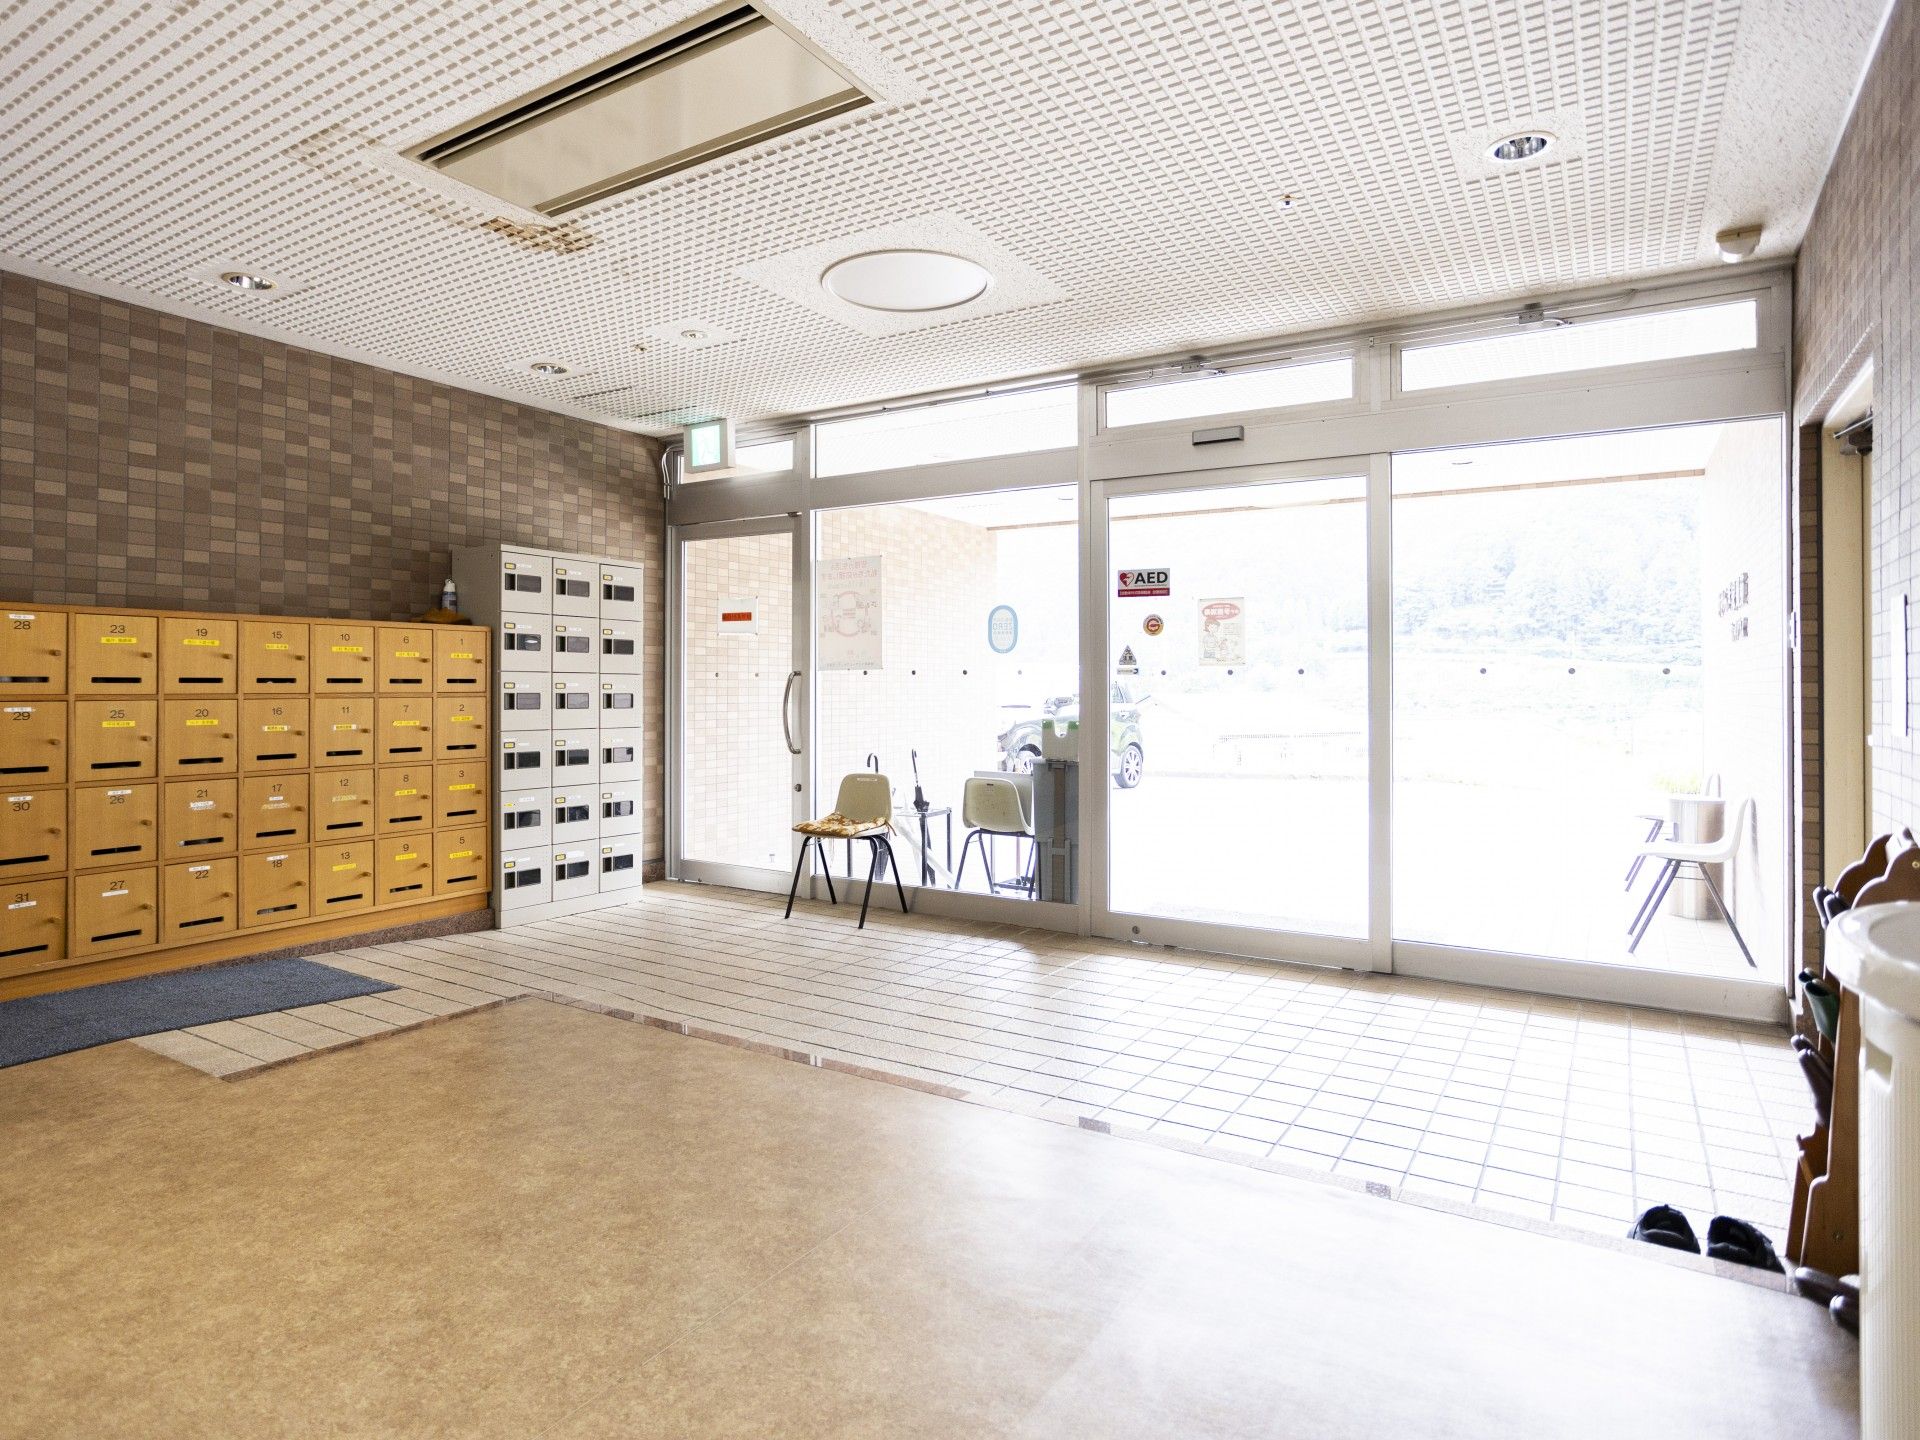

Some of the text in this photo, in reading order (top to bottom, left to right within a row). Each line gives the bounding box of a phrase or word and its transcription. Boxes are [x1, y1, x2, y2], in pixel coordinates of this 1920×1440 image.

[1134, 571, 1168, 584] AED
[14, 620, 31, 630] 28
[110, 624, 126, 634] 23
[195, 628, 208, 637] 19
[271, 631, 283, 639] 15
[340, 633, 351, 641] 10
[403, 636, 410, 644] 6
[272, 707, 283, 716] 16
[341, 706, 350, 714] 11
[403, 704, 410, 712] 7
[458, 704, 465, 712] 2
[13, 711, 31, 721] 29
[110, 709, 125, 719] 25
[195, 708, 209, 718] 20
[403, 774, 409, 782] 8
[458, 770, 465, 778] 3
[338, 778, 349, 787] 12
[272, 783, 283, 792] 17
[196, 789, 208, 798] 21
[109, 794, 125, 805] 26
[12, 801, 31, 812] 30
[459, 836, 466, 845] 5
[403, 843, 410, 852] 9
[340, 851, 351, 860] 13
[272, 860, 283, 868] 18
[195, 869, 209, 880] 22
[109, 880, 125, 891] 27
[14, 892, 30, 903] 31
